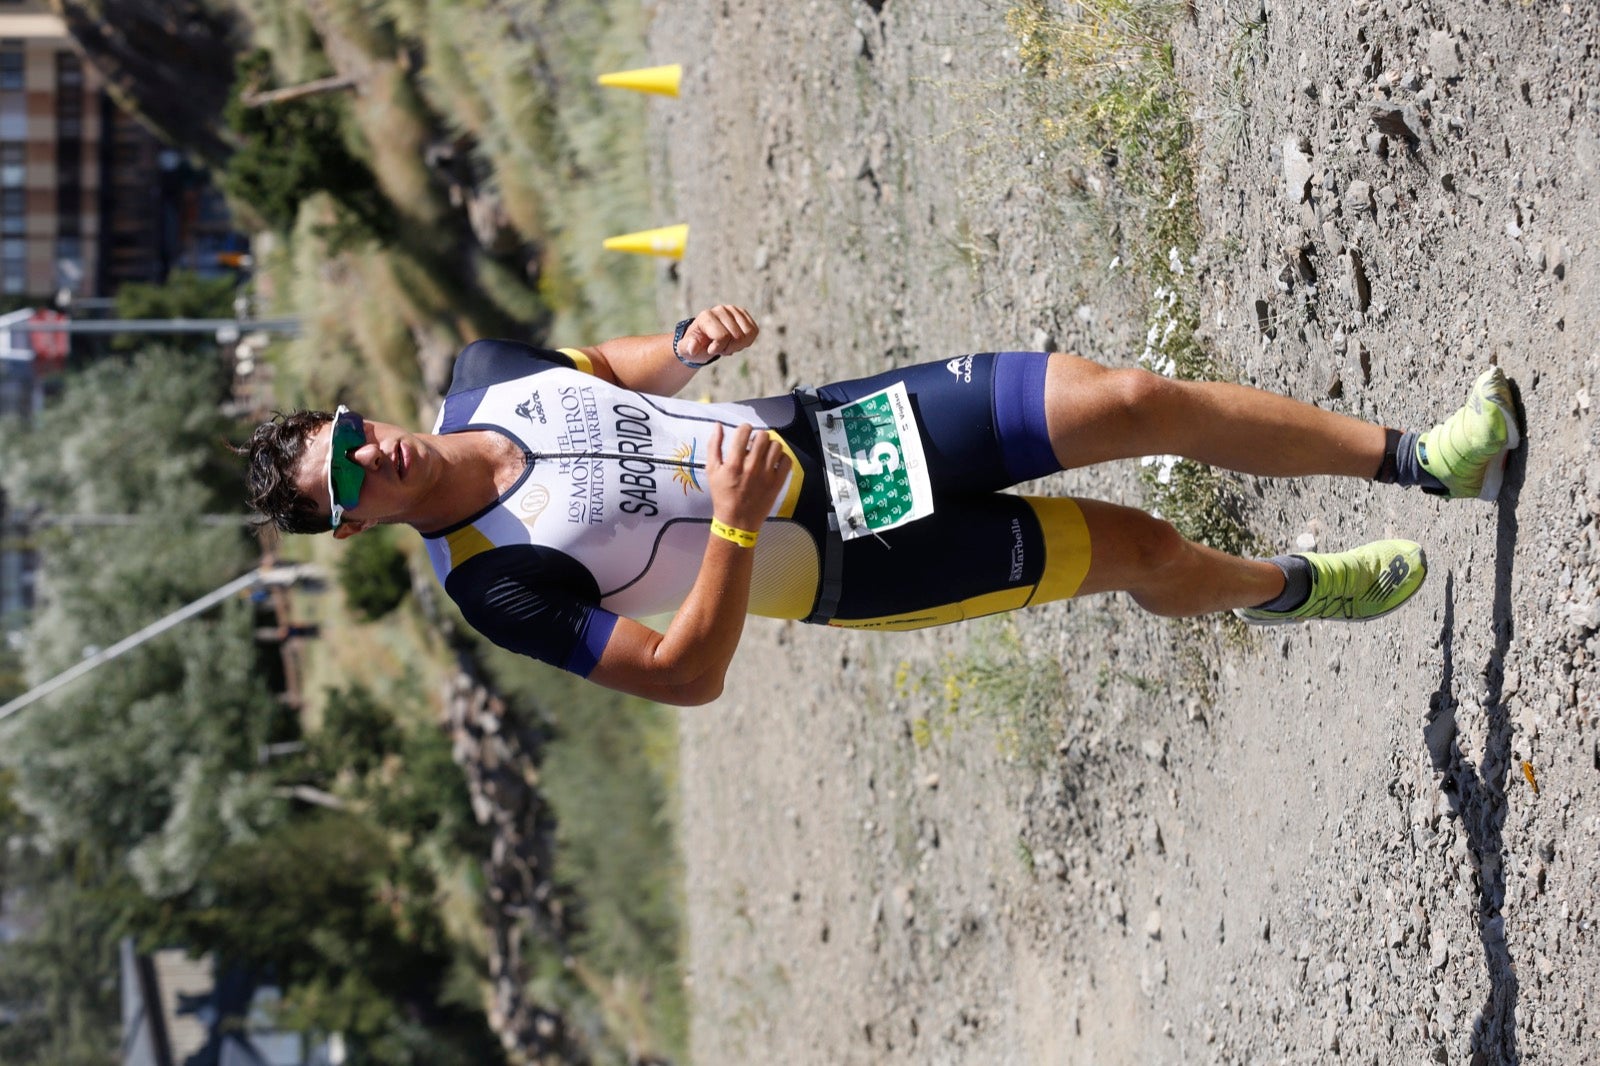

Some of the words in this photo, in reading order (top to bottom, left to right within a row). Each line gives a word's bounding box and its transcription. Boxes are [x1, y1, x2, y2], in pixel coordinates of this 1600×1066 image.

[558, 386, 589, 499] MONTEROS
[581, 386, 605, 454] MARBELLA
[557, 432, 571, 474] HOTEL
[612, 404, 659, 517] SABORIDO
[855, 441, 900, 476] 5
[567, 501, 581, 524] LOS
